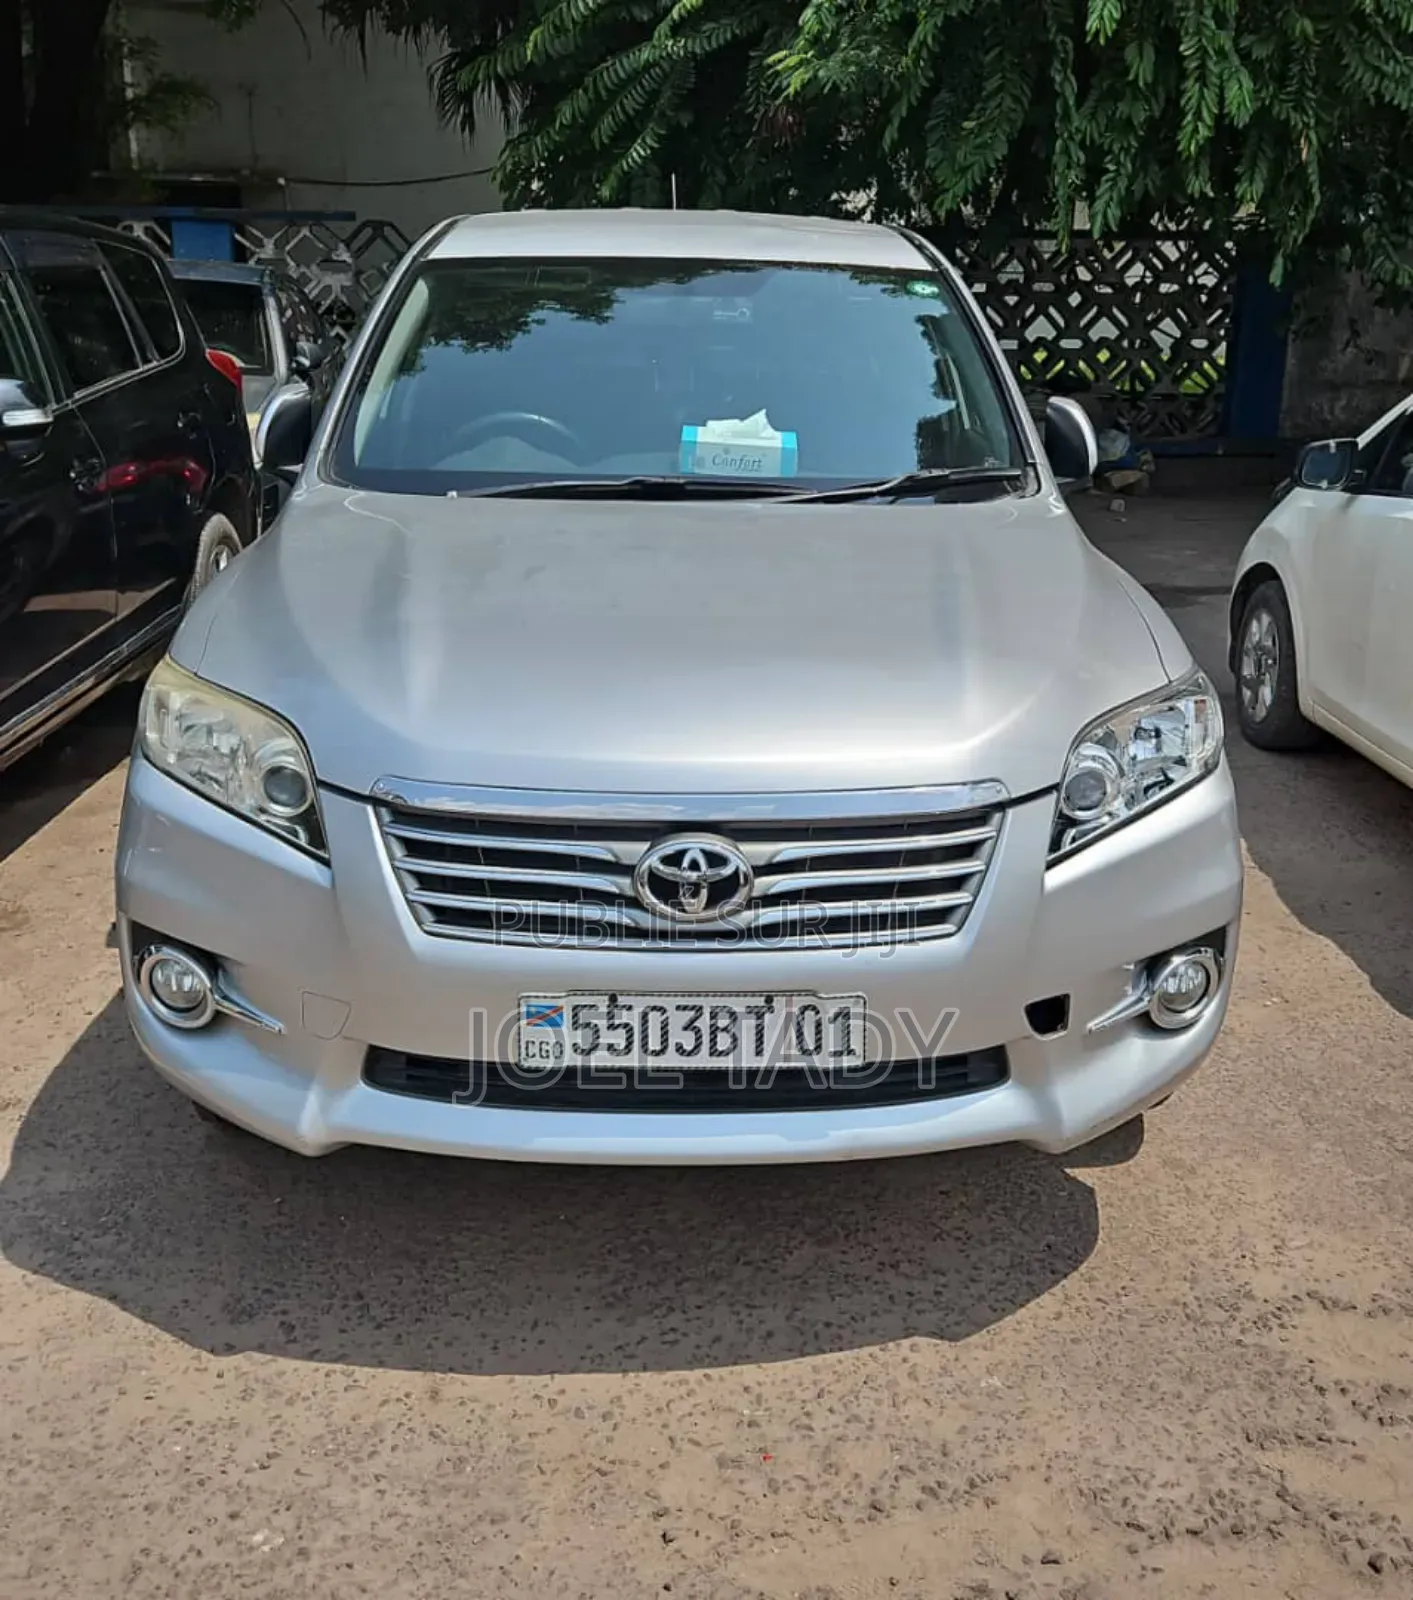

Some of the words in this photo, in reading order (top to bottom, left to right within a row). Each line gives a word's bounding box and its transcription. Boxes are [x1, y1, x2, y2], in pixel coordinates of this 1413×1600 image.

[525, 1039, 564, 1060] CGO
[571, 1003, 775, 1058] 5503BT
[796, 1004, 858, 1058] 01
